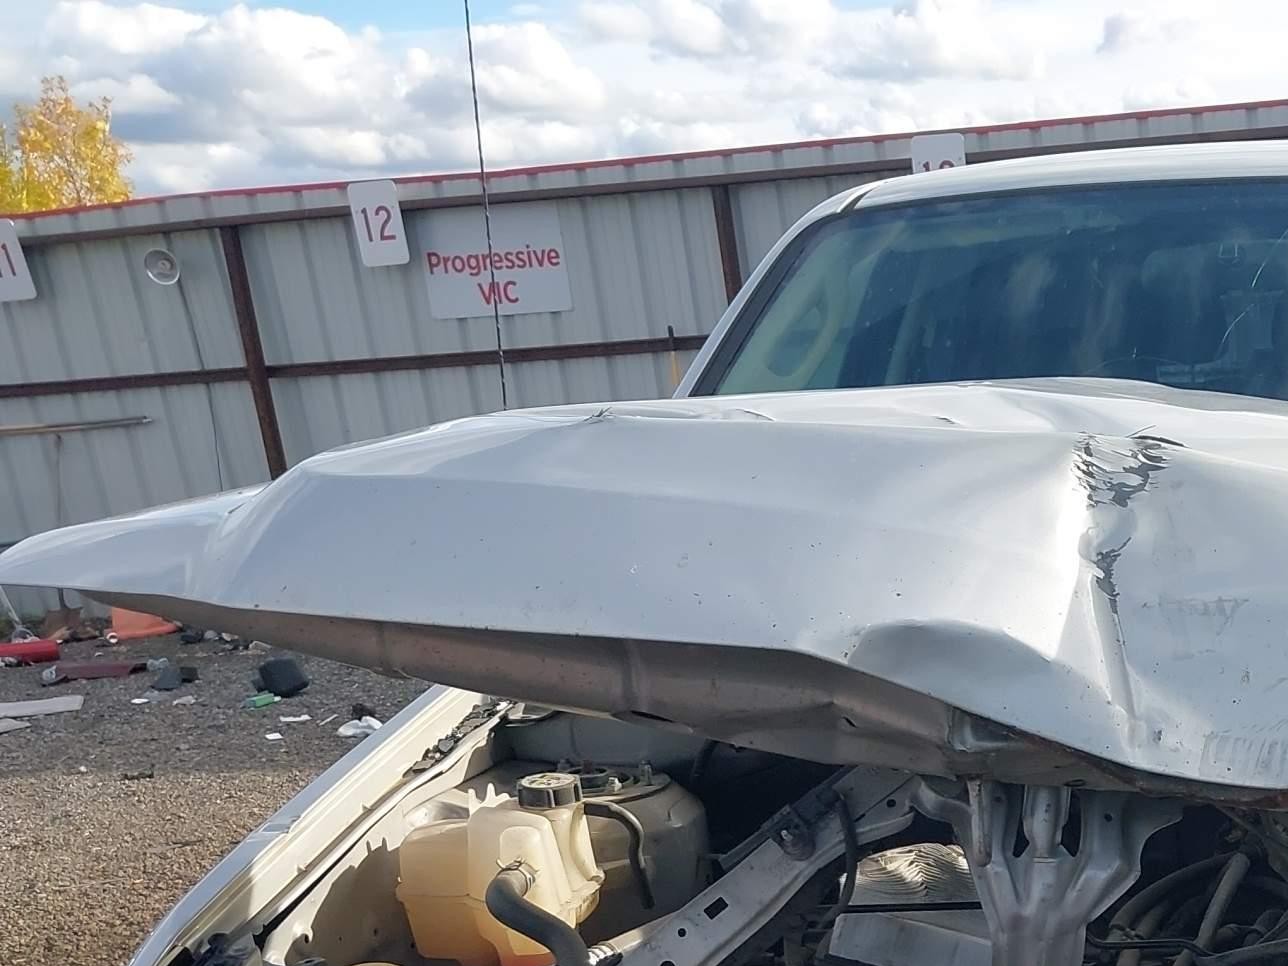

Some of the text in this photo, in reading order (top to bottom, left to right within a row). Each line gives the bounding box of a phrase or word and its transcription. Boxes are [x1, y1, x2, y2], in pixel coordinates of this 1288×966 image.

[360, 205, 397, 242] 12
[0, 243, 17, 277] 1
[426, 244, 561, 276] Progressive
[477, 281, 520, 305] VIC
